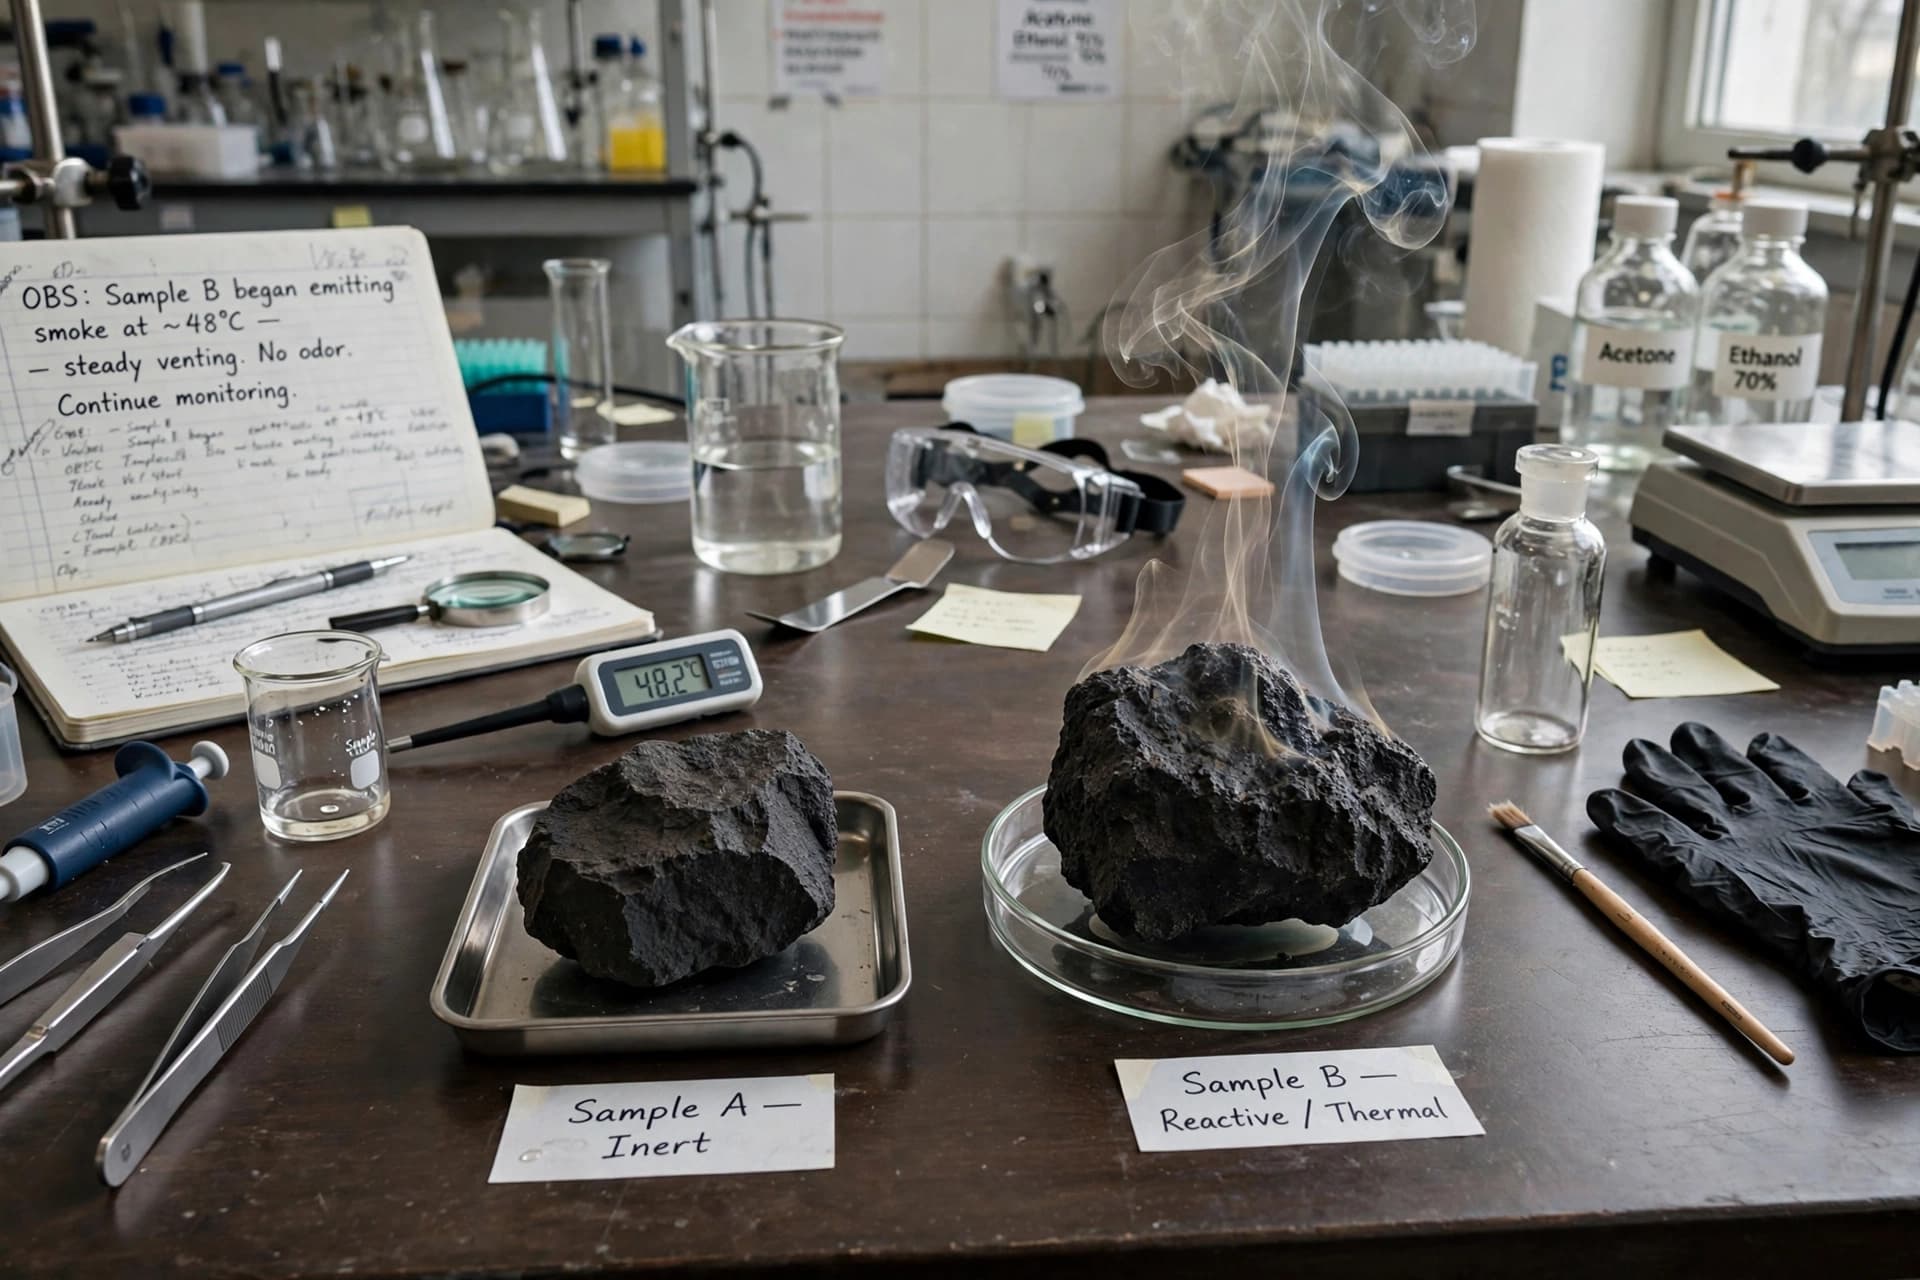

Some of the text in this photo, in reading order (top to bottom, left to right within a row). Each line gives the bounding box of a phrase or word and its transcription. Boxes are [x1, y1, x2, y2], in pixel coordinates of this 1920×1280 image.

[22, 277, 395, 312] OBS: Sample B began emitting
[34, 318, 110, 344] smoke
[123, 316, 149, 338] at
[163, 310, 245, 335] ~48°C
[65, 350, 142, 384] steady
[157, 347, 246, 378] venting.
[258, 341, 288, 362] No
[299, 339, 352, 361] odor.
[1598, 340, 1677, 366] Acetone
[1729, 345, 1803, 368] Ethanol
[1734, 370, 1777, 392] 70%
[58, 392, 162, 417] Continue
[176, 381, 298, 411] monitoring.
[1182, 1066, 1305, 1101] Sample
[1319, 1064, 1348, 1089] B
[568, 1095, 701, 1130] Sample
[719, 1091, 748, 1118] A
[1160, 1107, 1290, 1133] Reactive
[1324, 1096, 1450, 1124] Thermal
[601, 1131, 712, 1160] Inert
